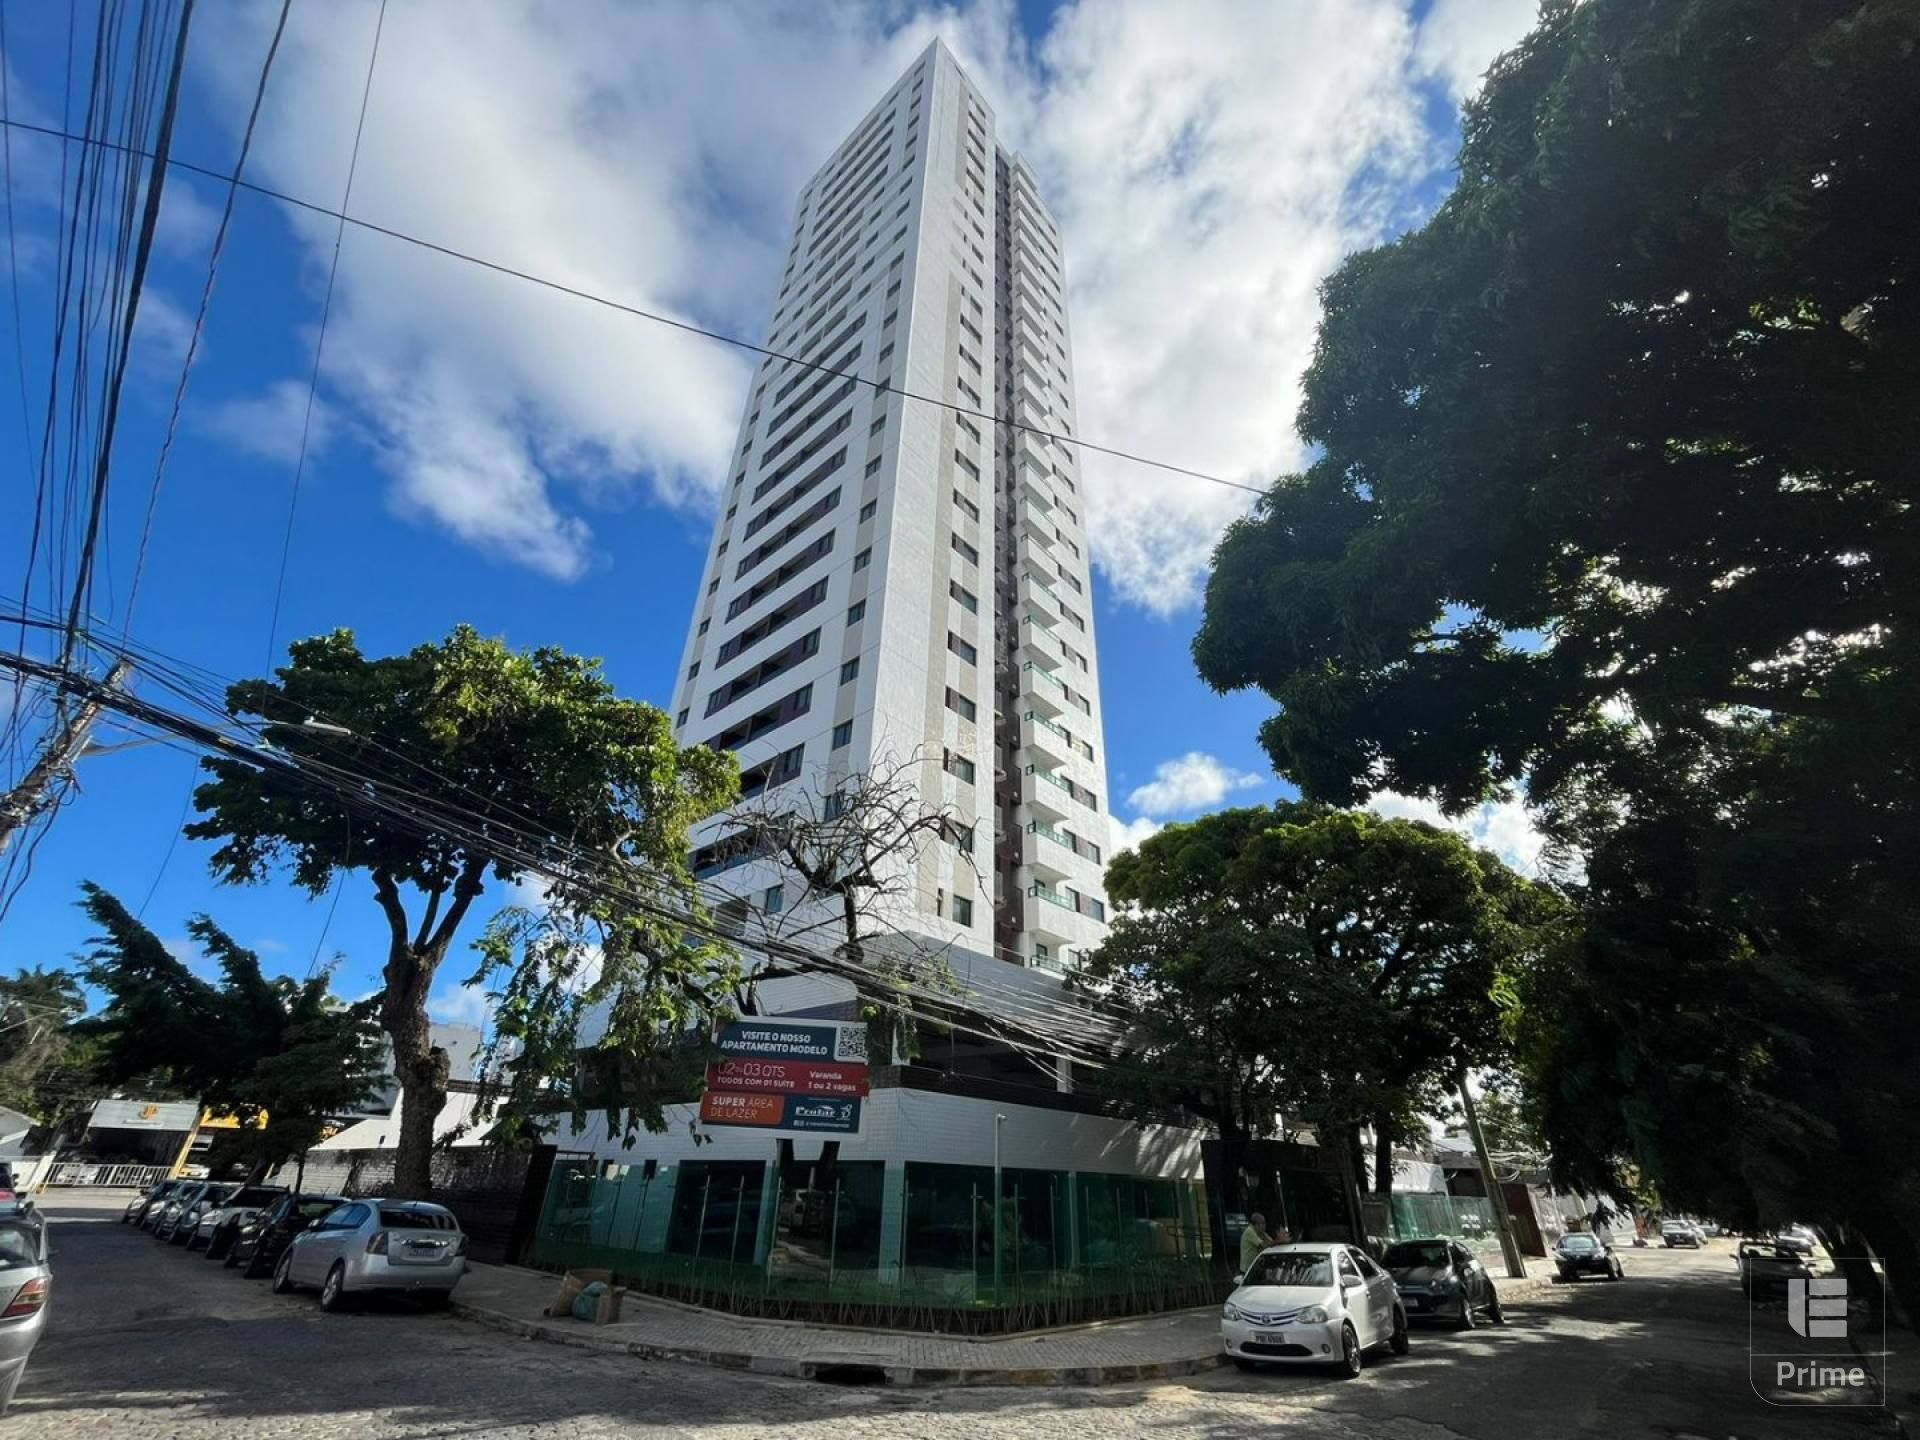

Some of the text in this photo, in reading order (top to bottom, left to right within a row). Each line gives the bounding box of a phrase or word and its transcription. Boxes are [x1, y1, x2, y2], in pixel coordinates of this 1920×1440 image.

[742, 1031, 811, 1043] VISITE O NOSSO
[721, 1040, 828, 1055] APARTAMENTO MODELO
[762, 1065, 785, 1078] QTS
[809, 1070, 842, 1080] Varanda
[717, 1076, 743, 1085] TODOS
[744, 1078, 762, 1086] COM
[763, 1079, 773, 1087] 01
[808, 1081, 812, 1089] 1
[825, 1082, 831, 1090] 2
[833, 1084, 856, 1092] vagas
[712, 1095, 746, 1107] SUPER
[711, 1106, 758, 1118] DE LAZER
